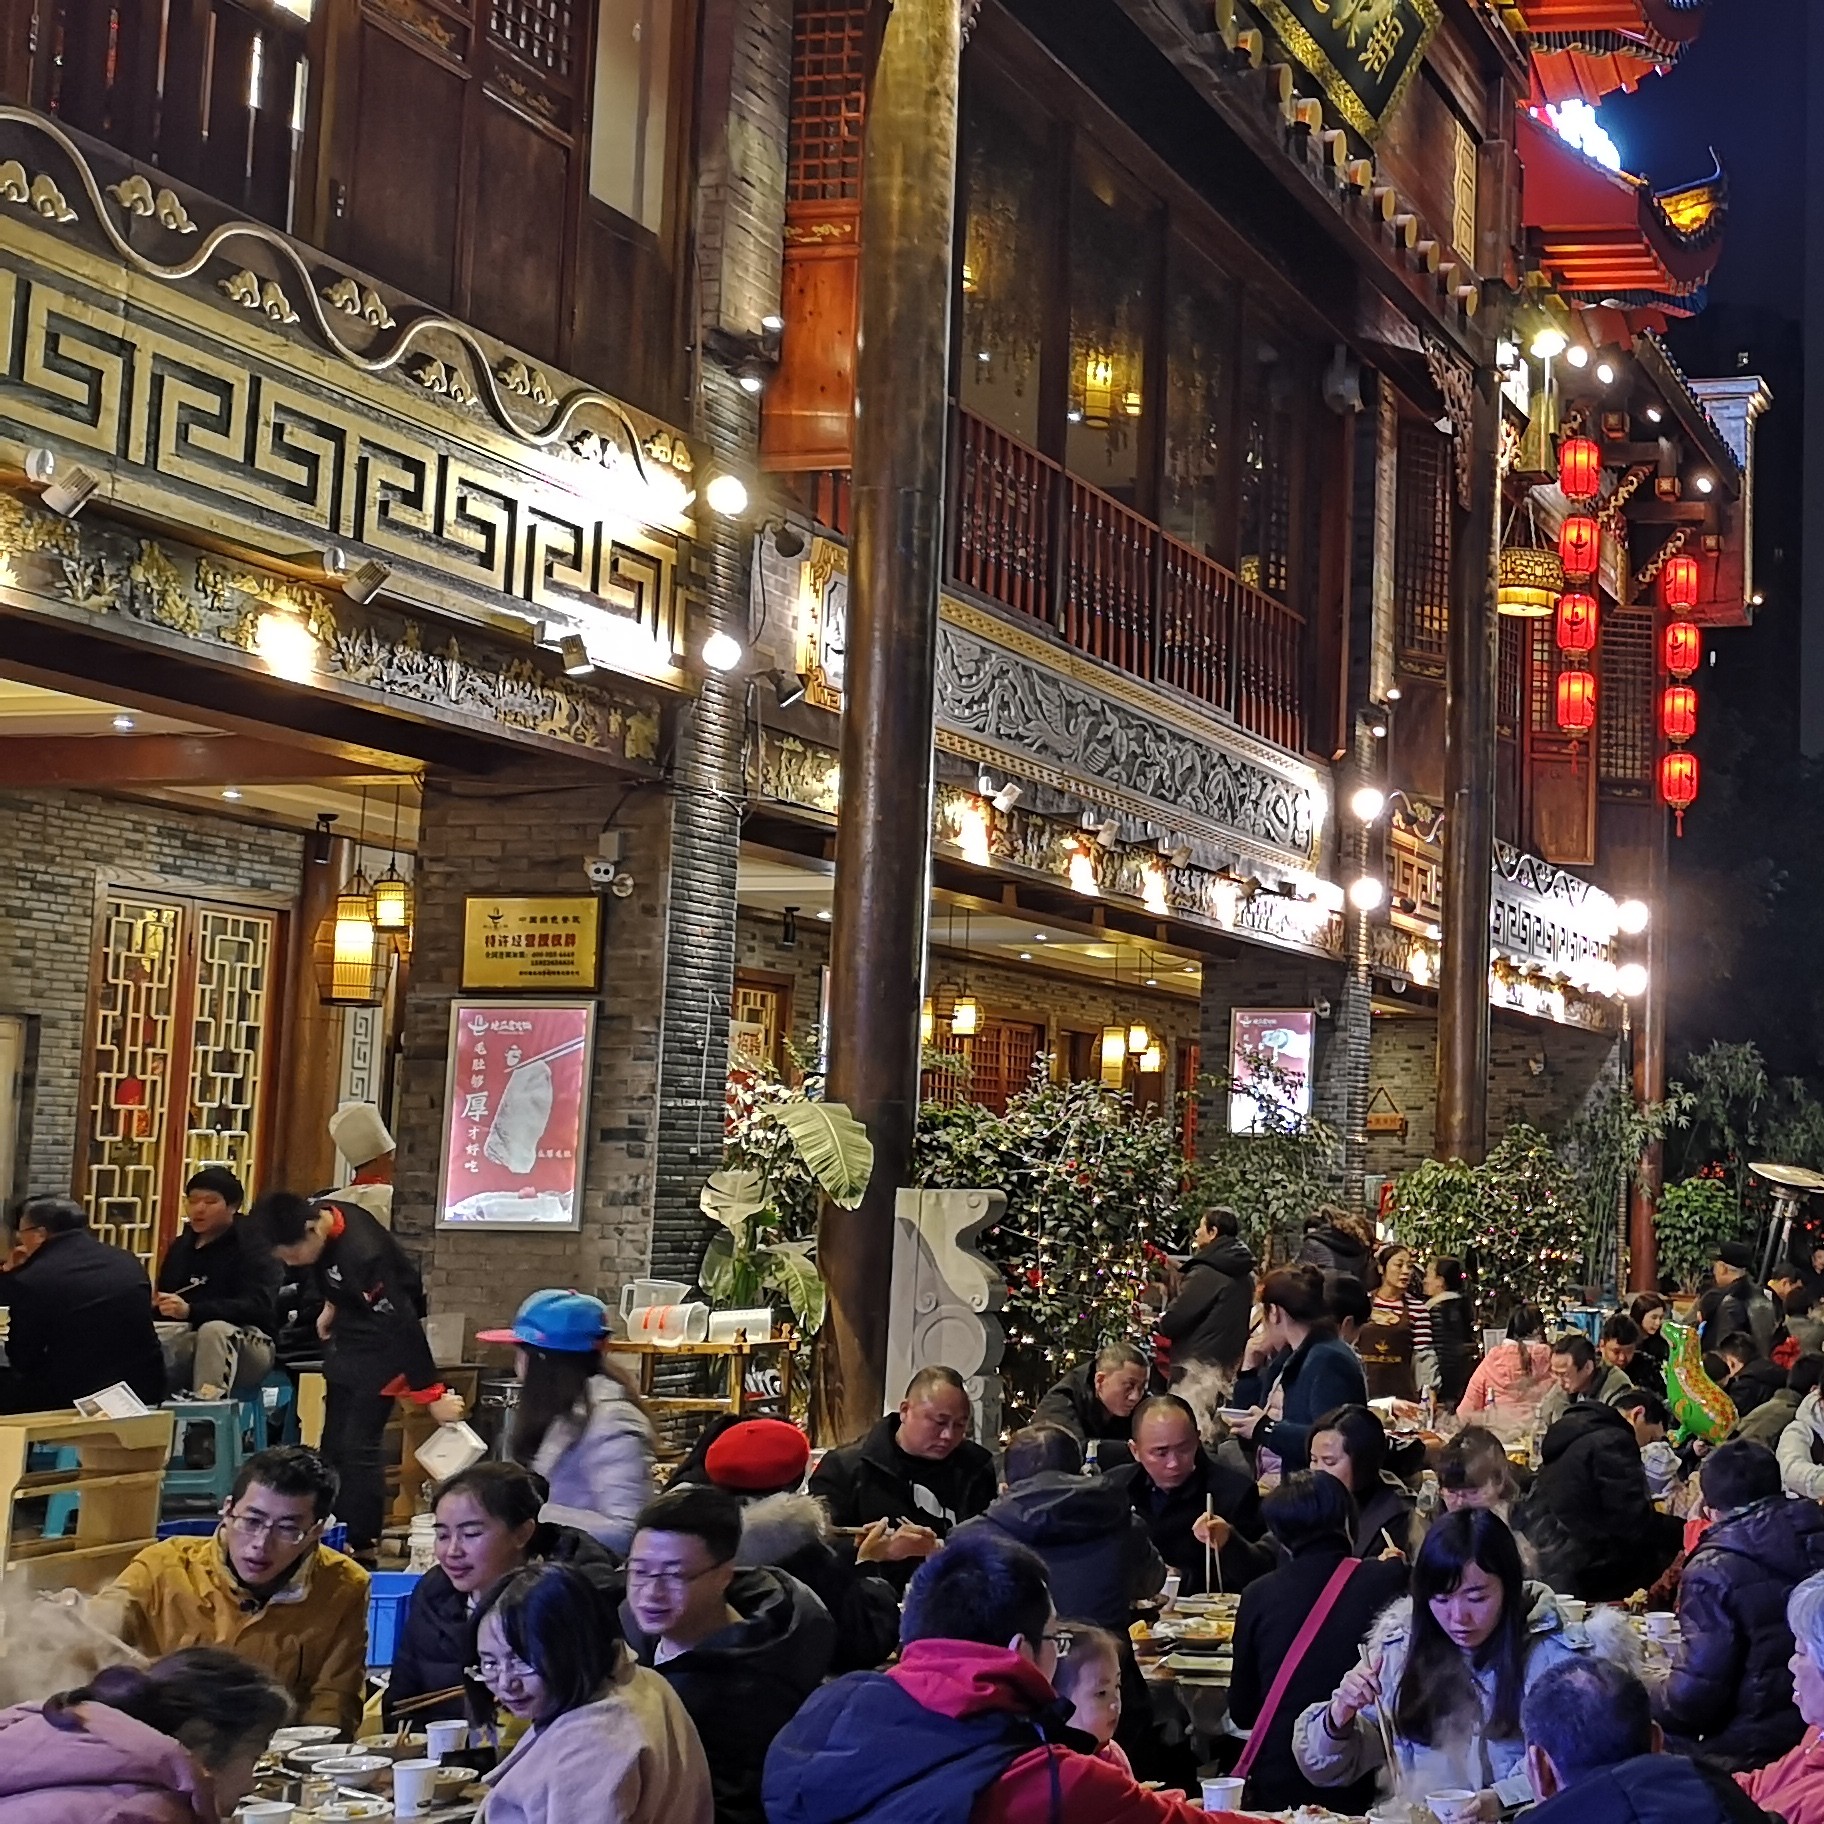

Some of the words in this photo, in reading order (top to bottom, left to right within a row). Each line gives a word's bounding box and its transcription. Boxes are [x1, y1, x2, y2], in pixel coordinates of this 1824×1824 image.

[484, 933, 577, 948] 特许经营授权牌
